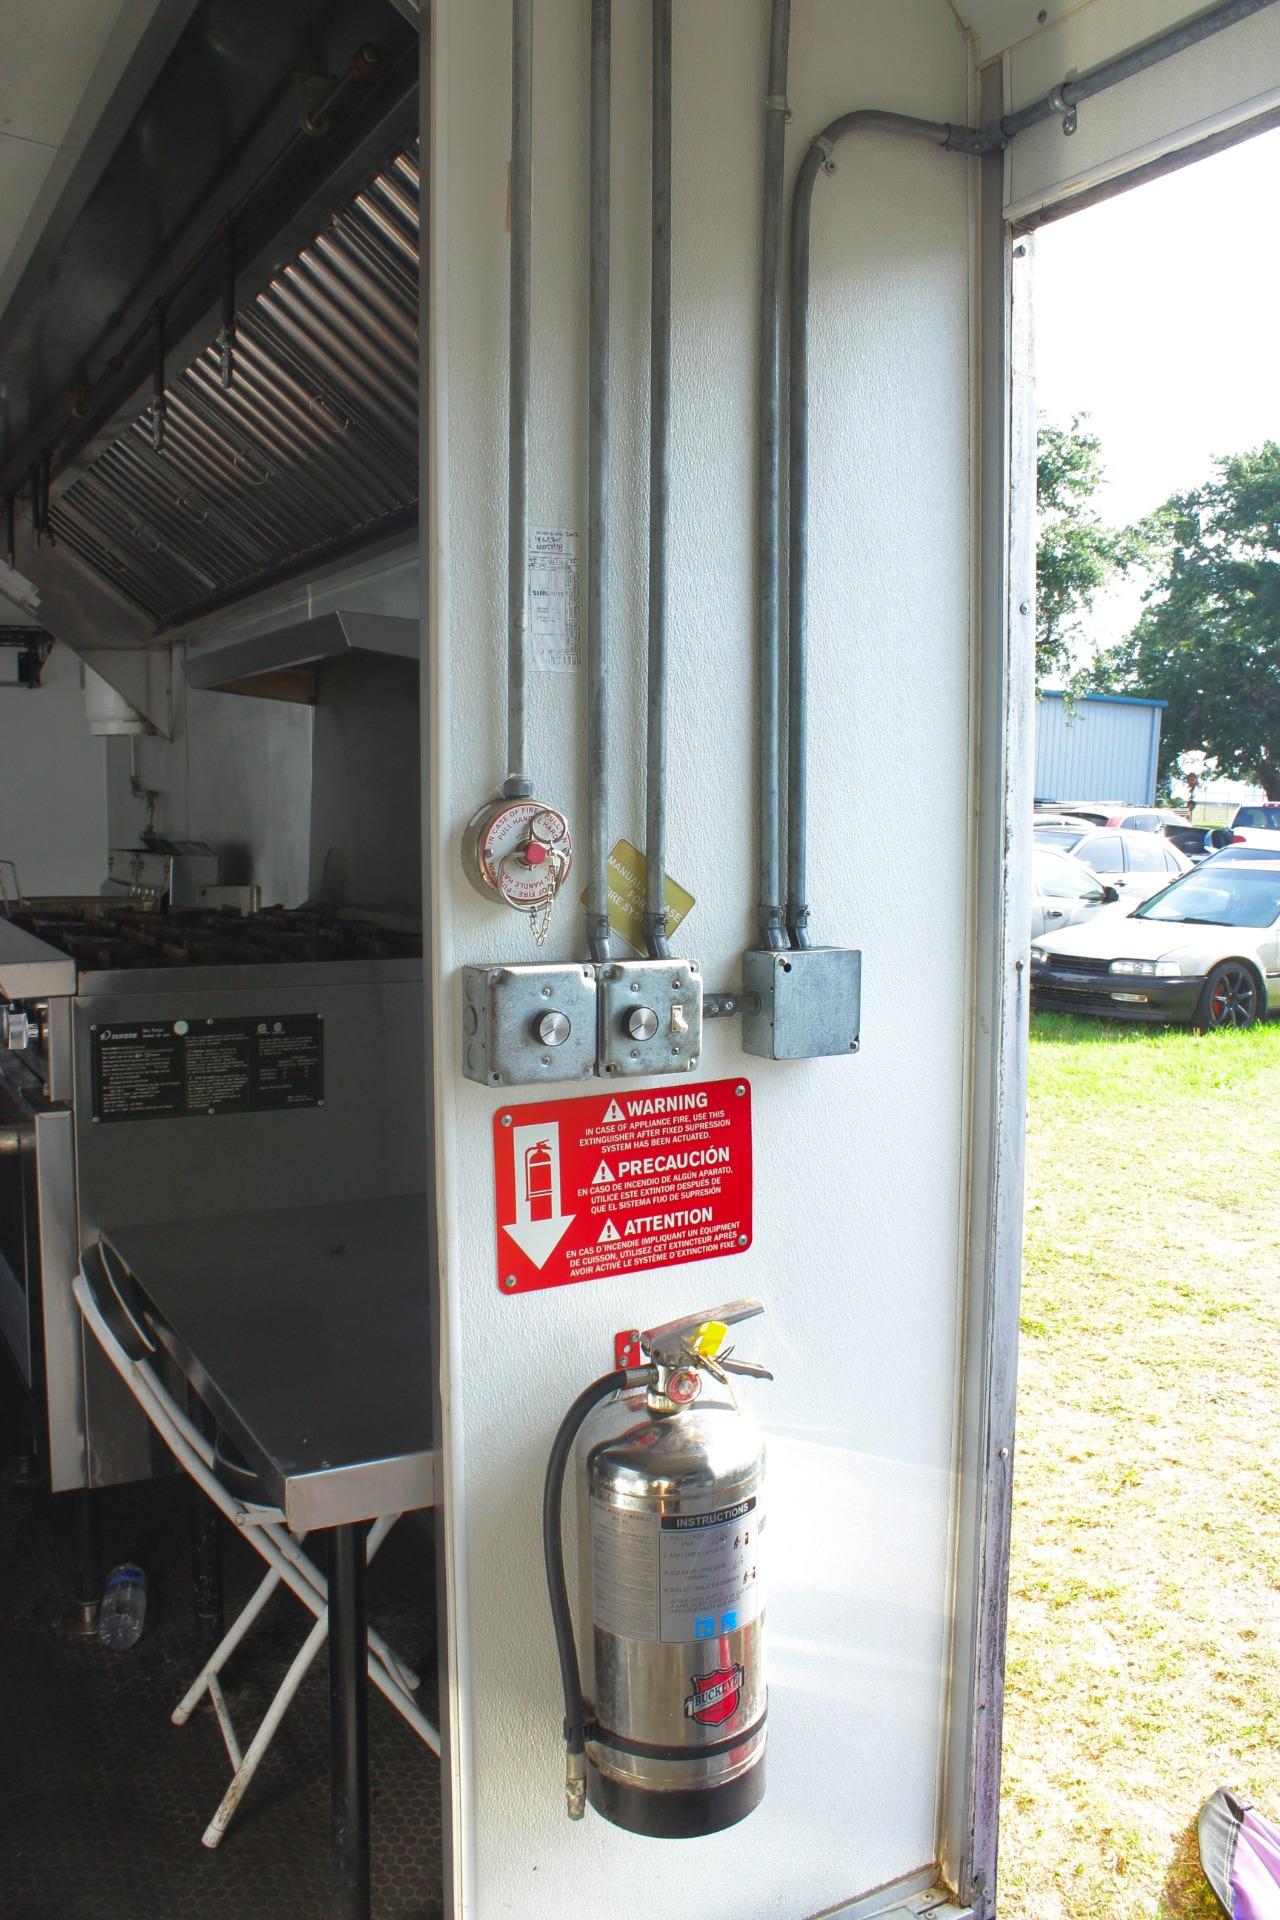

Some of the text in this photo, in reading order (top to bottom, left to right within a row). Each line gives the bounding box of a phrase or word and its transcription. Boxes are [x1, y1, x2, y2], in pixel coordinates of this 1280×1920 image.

[488, 837, 494, 845] IN
[493, 817, 508, 835] CASE
[509, 808, 519, 818] OF
[545, 813, 561, 830] PULL
[498, 825, 513, 841] PULL
[607, 856, 641, 889] MANUAL
[627, 1092, 708, 1117] WARNING
[580, 1119, 731, 1146] EXTINGUISHER AFTER FIXED SUPRESSION
[596, 1124, 616, 1134] CASE
[618, 1123, 627, 1131] OF
[630, 1117, 671, 1129] APPLIANCE
[694, 1112, 707, 1121] USE
[710, 1110, 725, 1118] THIS
[602, 1131, 710, 1153] SYSTEM HAS BEEN ACTUATED.
[619, 1145, 730, 1178] PRECAUCIÓN
[578, 1188, 588, 1196] EN
[590, 1184, 611, 1194] CASO
[613, 1182, 623, 1190] DE
[625, 1177, 660, 1188] INCENDIO
[662, 1175, 671, 1183] DE
[592, 1192, 619, 1203] UTILICE
[621, 1189, 639, 1199] ESTE
[641, 1184, 675, 1196] EXTINTOR
[712, 1176, 721, 1184] DE
[591, 1204, 607, 1214] QUE
[620, 1197, 651, 1209] SISTEMA
[653, 1194, 668, 1203] FIJO
[670, 1192, 679, 1201] DE
[681, 1186, 721, 1199] SUPRESIÓN
[624, 1207, 713, 1236] ATTENTION
[567, 1250, 577, 1258] EN
[579, 1246, 595, 1256] CAS
[642, 1230, 687, 1244] IMPLIQUANT
[570, 1258, 581, 1267] DE
[620, 1246, 652, 1258] UTILISEZ
[654, 1243, 667, 1252] CET
[669, 1235, 713, 1249] EXTINCTEUR
[571, 1266, 594, 1276] AVOIR
[596, 1259, 621, 1271] ACTIVÉ
[624, 1258, 633, 1267] LE
[676, 1502, 749, 1528] INSTRUCTIONS
[695, 1675, 738, 1706] BUCKEYE
